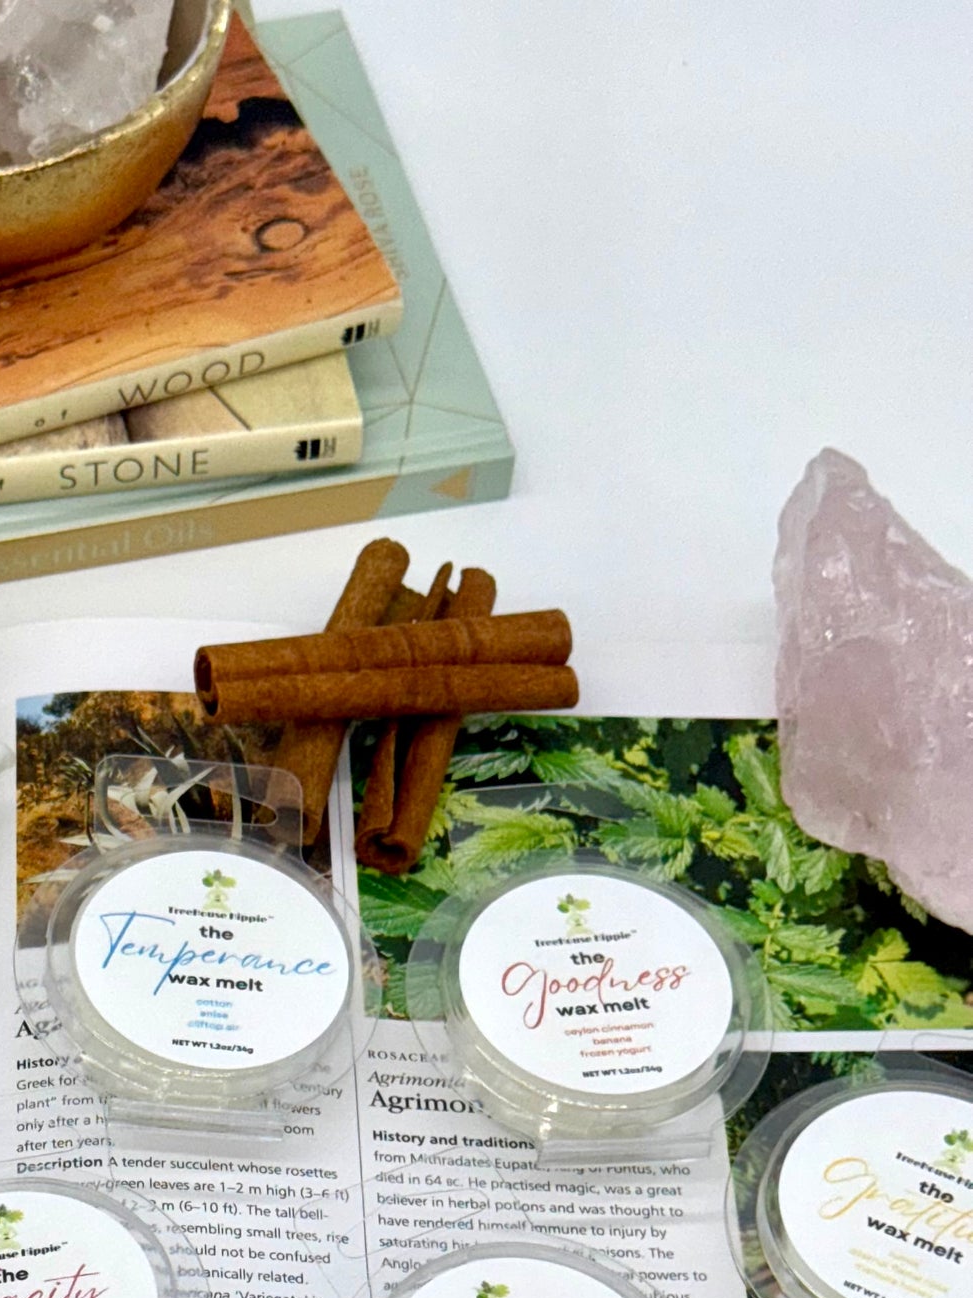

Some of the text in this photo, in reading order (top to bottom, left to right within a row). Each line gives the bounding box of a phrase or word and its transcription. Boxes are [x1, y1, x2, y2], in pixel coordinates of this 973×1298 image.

[34, 409, 68, 429] of
[118, 351, 266, 408] WOOD
[59, 449, 210, 491] STONE
[199, 926, 234, 940] the
[99, 910, 338, 996] Temperance
[570, 952, 605, 965] the
[168, 974, 263, 992] wax melt
[555, 997, 650, 1017] wax melt
[593, 1036, 632, 1045] banana
[583, 1070, 600, 1078] NET
[369, 1090, 488, 1116] Agrimon
[373, 1131, 536, 1151] History and traditions
[16, 1156, 103, 1174] Description
[919, 1181, 954, 1203] the
[867, 1216, 964, 1264] wax melt
[844, 1280, 862, 1293] NET
[863, 1288, 880, 1298] WT
